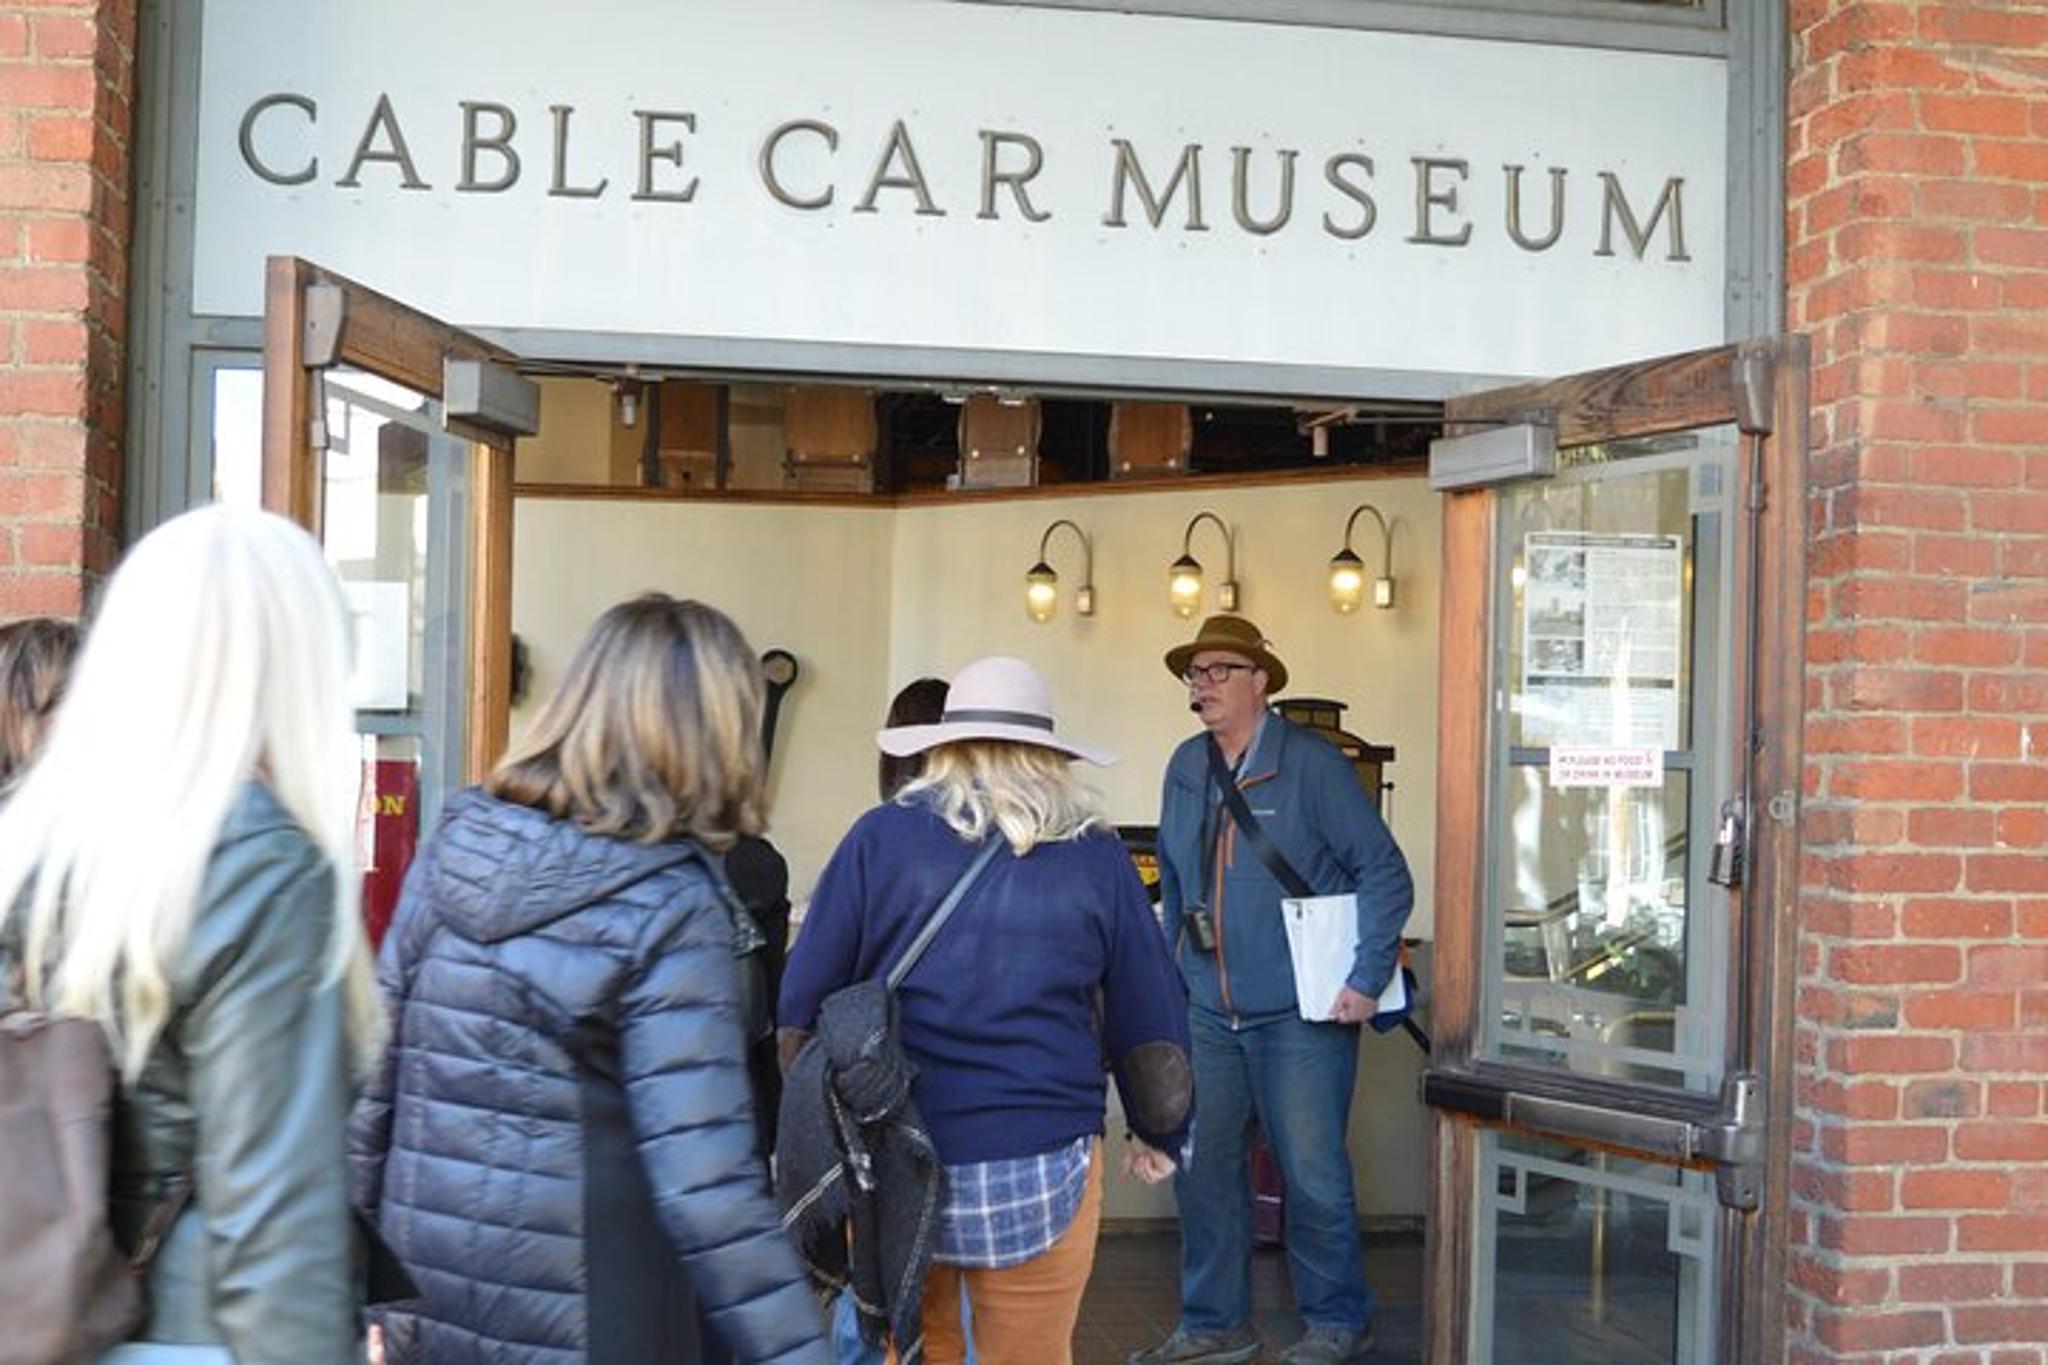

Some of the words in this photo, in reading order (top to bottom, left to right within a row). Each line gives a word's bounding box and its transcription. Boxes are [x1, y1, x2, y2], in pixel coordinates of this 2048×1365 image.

[237, 92, 701, 203] CABLE
[758, 118, 1052, 224] CAR
[1101, 138, 1692, 262] MUSEUM
